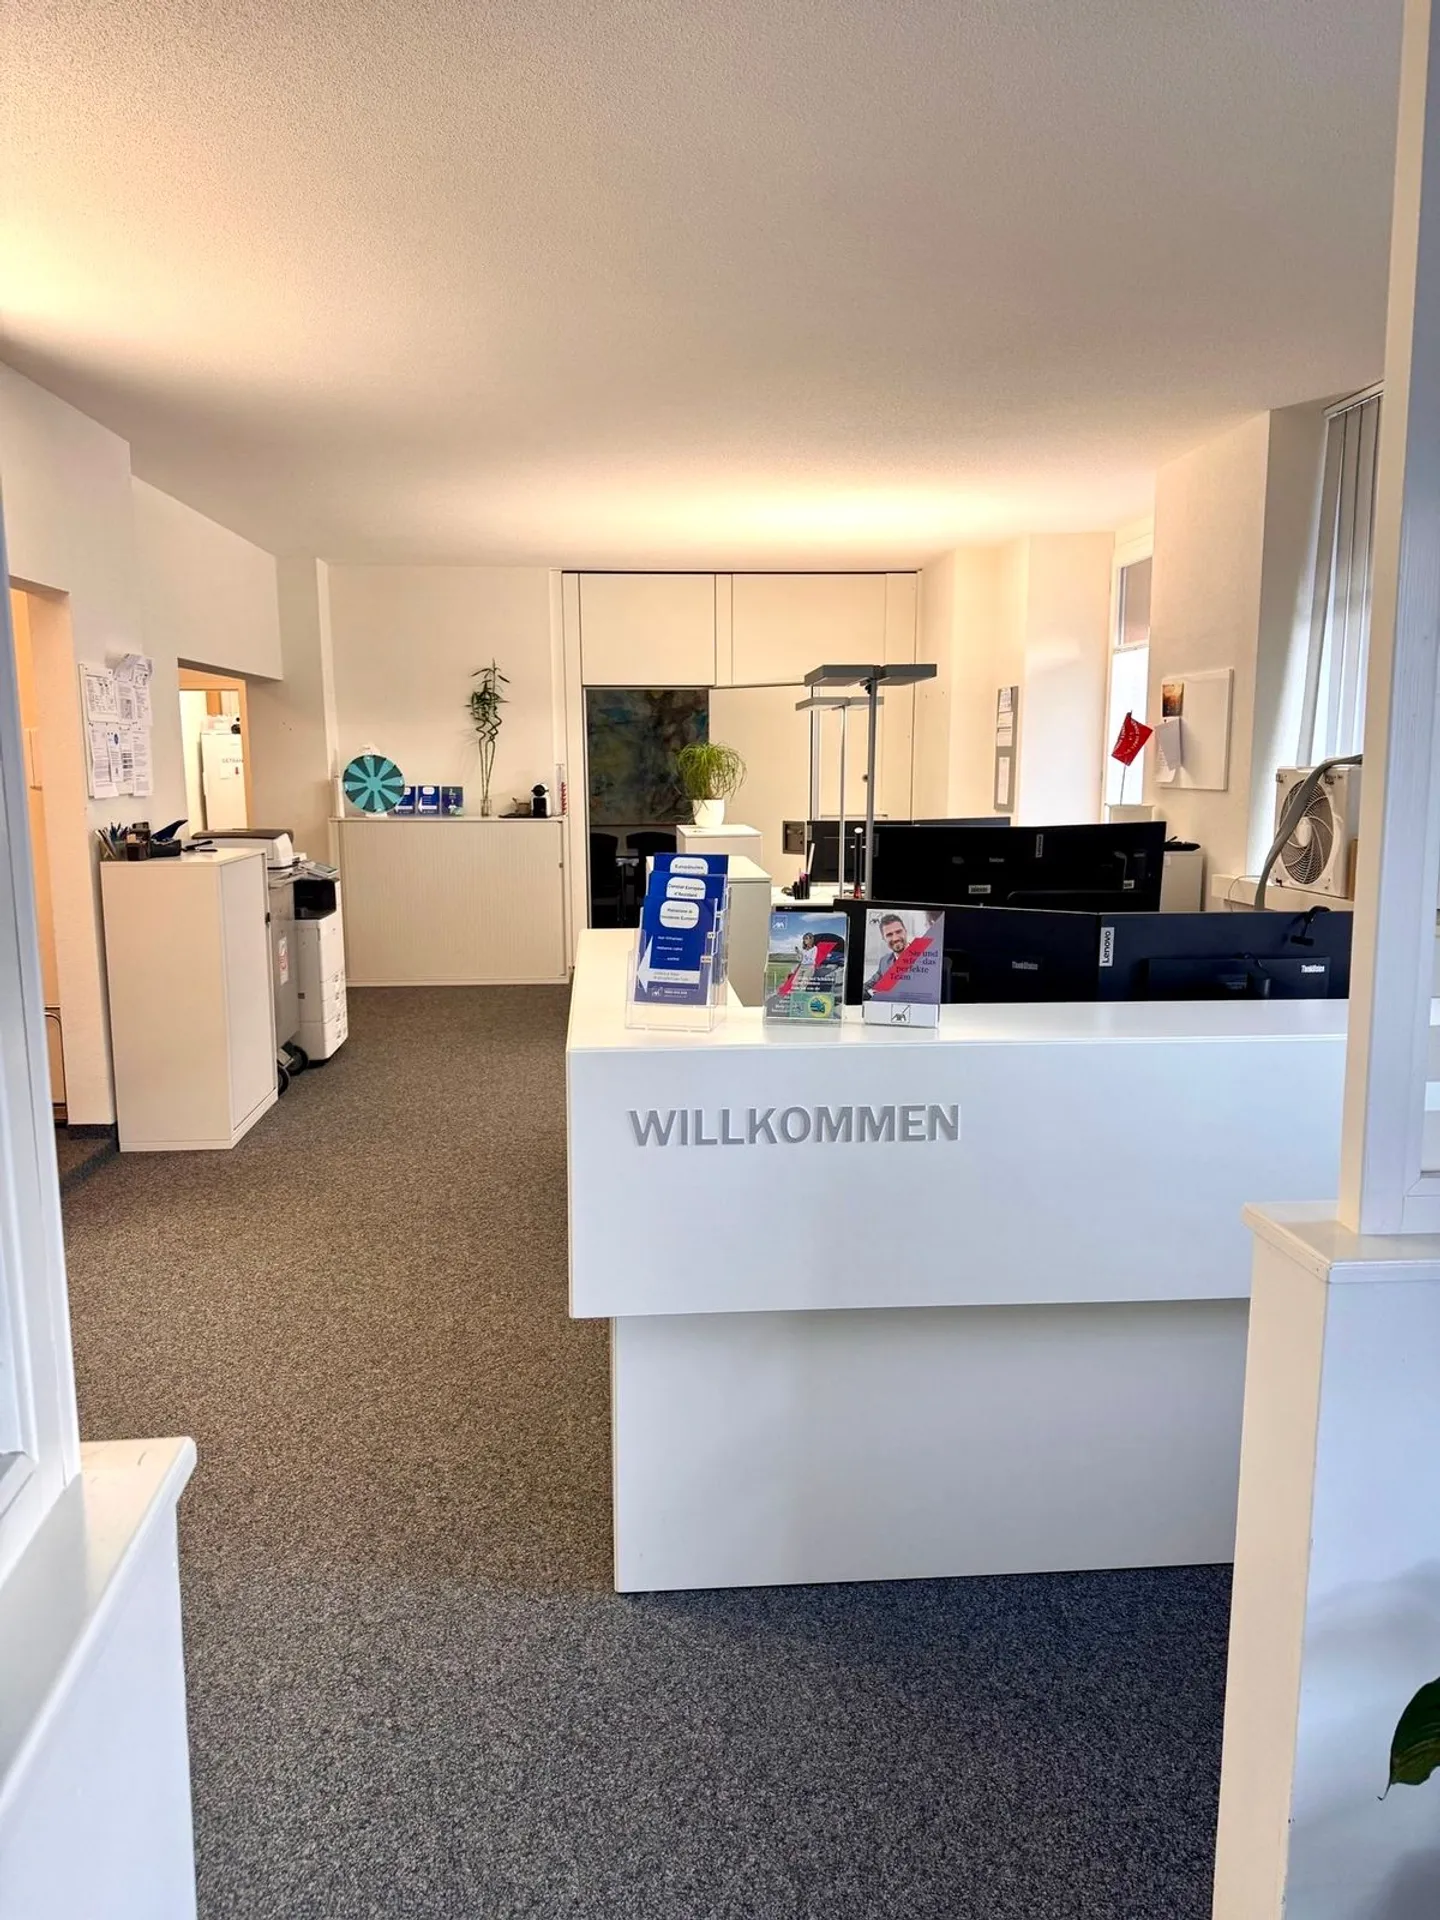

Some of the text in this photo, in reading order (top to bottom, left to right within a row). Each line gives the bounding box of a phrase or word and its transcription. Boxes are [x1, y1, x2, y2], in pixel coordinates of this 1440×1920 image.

[1102, 930, 1112, 964] Lenovo
[896, 965, 930, 973] perfekte
[922, 957, 936, 965] das
[627, 1104, 961, 1147] WILLKOMMEN
